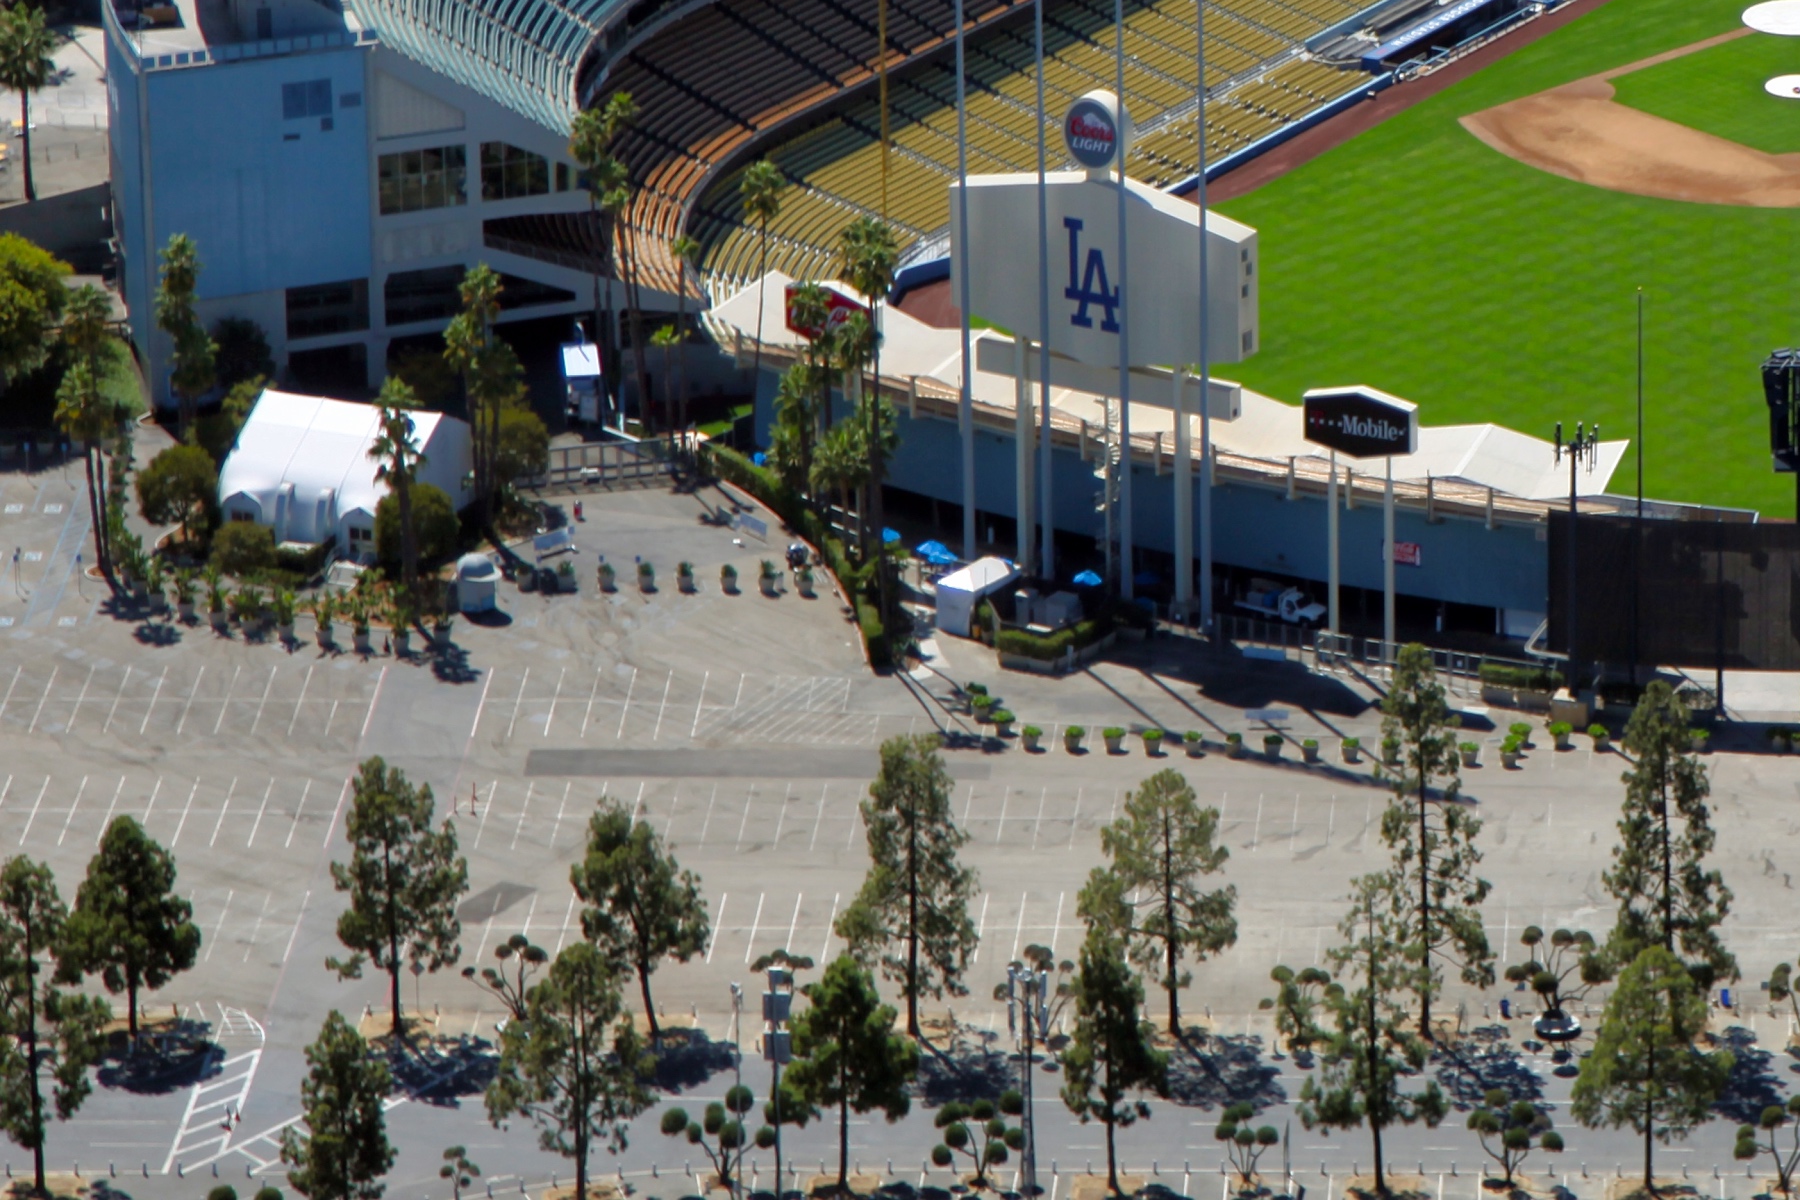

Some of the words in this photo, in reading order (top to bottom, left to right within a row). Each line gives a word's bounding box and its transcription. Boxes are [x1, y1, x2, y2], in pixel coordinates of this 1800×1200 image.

[1069, 116, 1114, 142] Coors
[1072, 137, 1110, 153] LIGHT
[1063, 216, 1120, 334] LA
